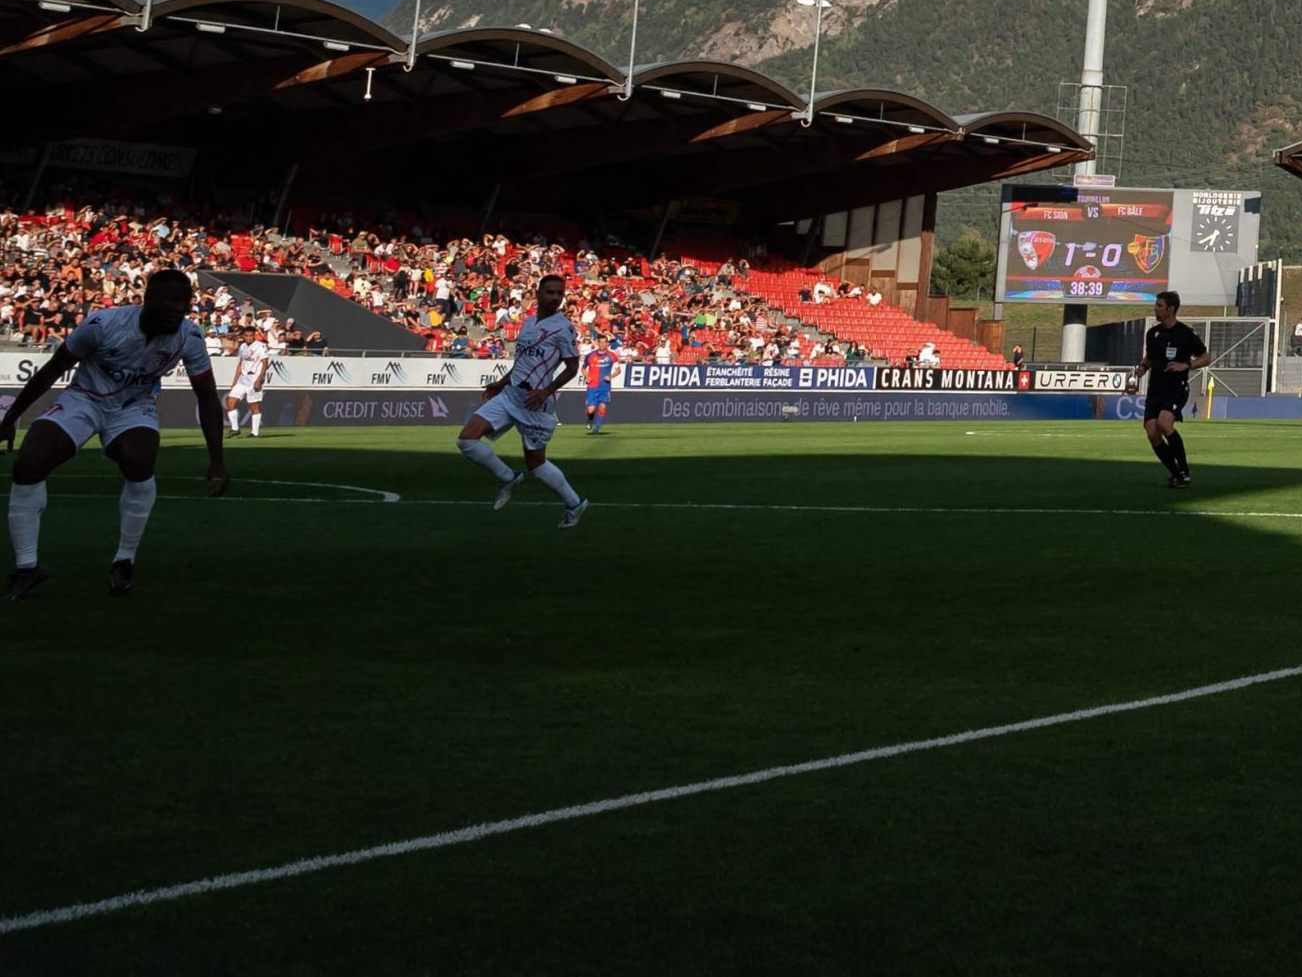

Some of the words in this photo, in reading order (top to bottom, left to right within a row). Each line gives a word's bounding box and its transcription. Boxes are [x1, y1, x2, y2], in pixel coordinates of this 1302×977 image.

[1044, 211, 1053, 220] FC
[1053, 211, 1069, 220] SION
[1087, 207, 1099, 218] VS
[1118, 206, 1127, 216] FC
[1064, 242, 1076, 267] 1
[1101, 243, 1123, 267] 0
[1070, 281, 1104, 295] 38:39
[312, 373, 334, 385] FMV
[372, 373, 391, 385] FMV
[427, 374, 447, 385] FMV
[648, 366, 701, 387] PHIDA
[705, 378, 761, 387] FERBLANTERIE
[763, 378, 793, 388] FAÇADE
[816, 368, 867, 388] PHIDA
[881, 369, 934, 388] CRANS
[940, 370, 1014, 389] MONTANA
[1040, 373, 1110, 388] URFER
[323, 401, 378, 418] CREDIT
[381, 401, 425, 418] SUISSE
[662, 397, 690, 418] Des
[794, 397, 810, 416] de
[813, 397, 840, 417] rêve
[844, 399, 881, 416] même
[885, 402, 911, 420] pour
[915, 399, 925, 416] la
[927, 399, 969, 420] banque
